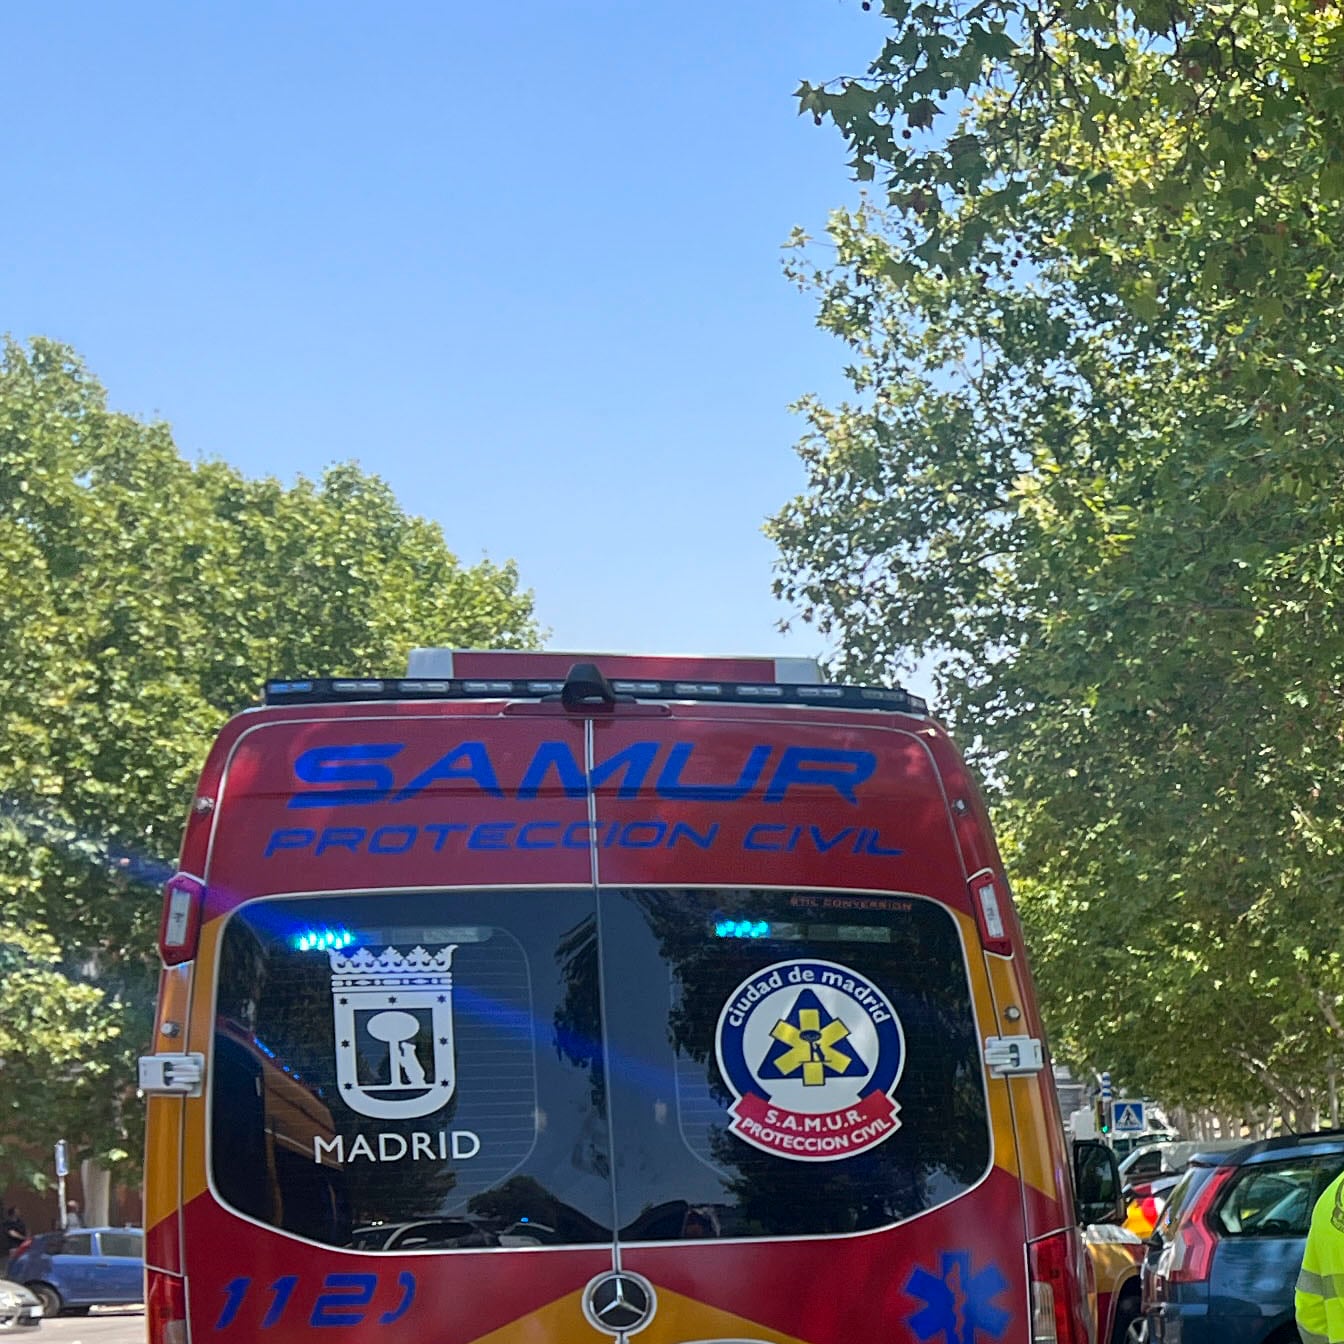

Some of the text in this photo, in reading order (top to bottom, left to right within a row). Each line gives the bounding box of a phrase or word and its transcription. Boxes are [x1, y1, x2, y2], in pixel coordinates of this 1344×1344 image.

[287, 740, 878, 809] SAMUR
[263, 820, 906, 859] PROTECCION CIVIL
[728, 966, 891, 1028] ciudad de madrid
[741, 1116, 891, 1152] PROTECCION CIVIL
[764, 1109, 868, 1132] S.A.M.U.R.
[313, 1130, 481, 1164] MADRID
